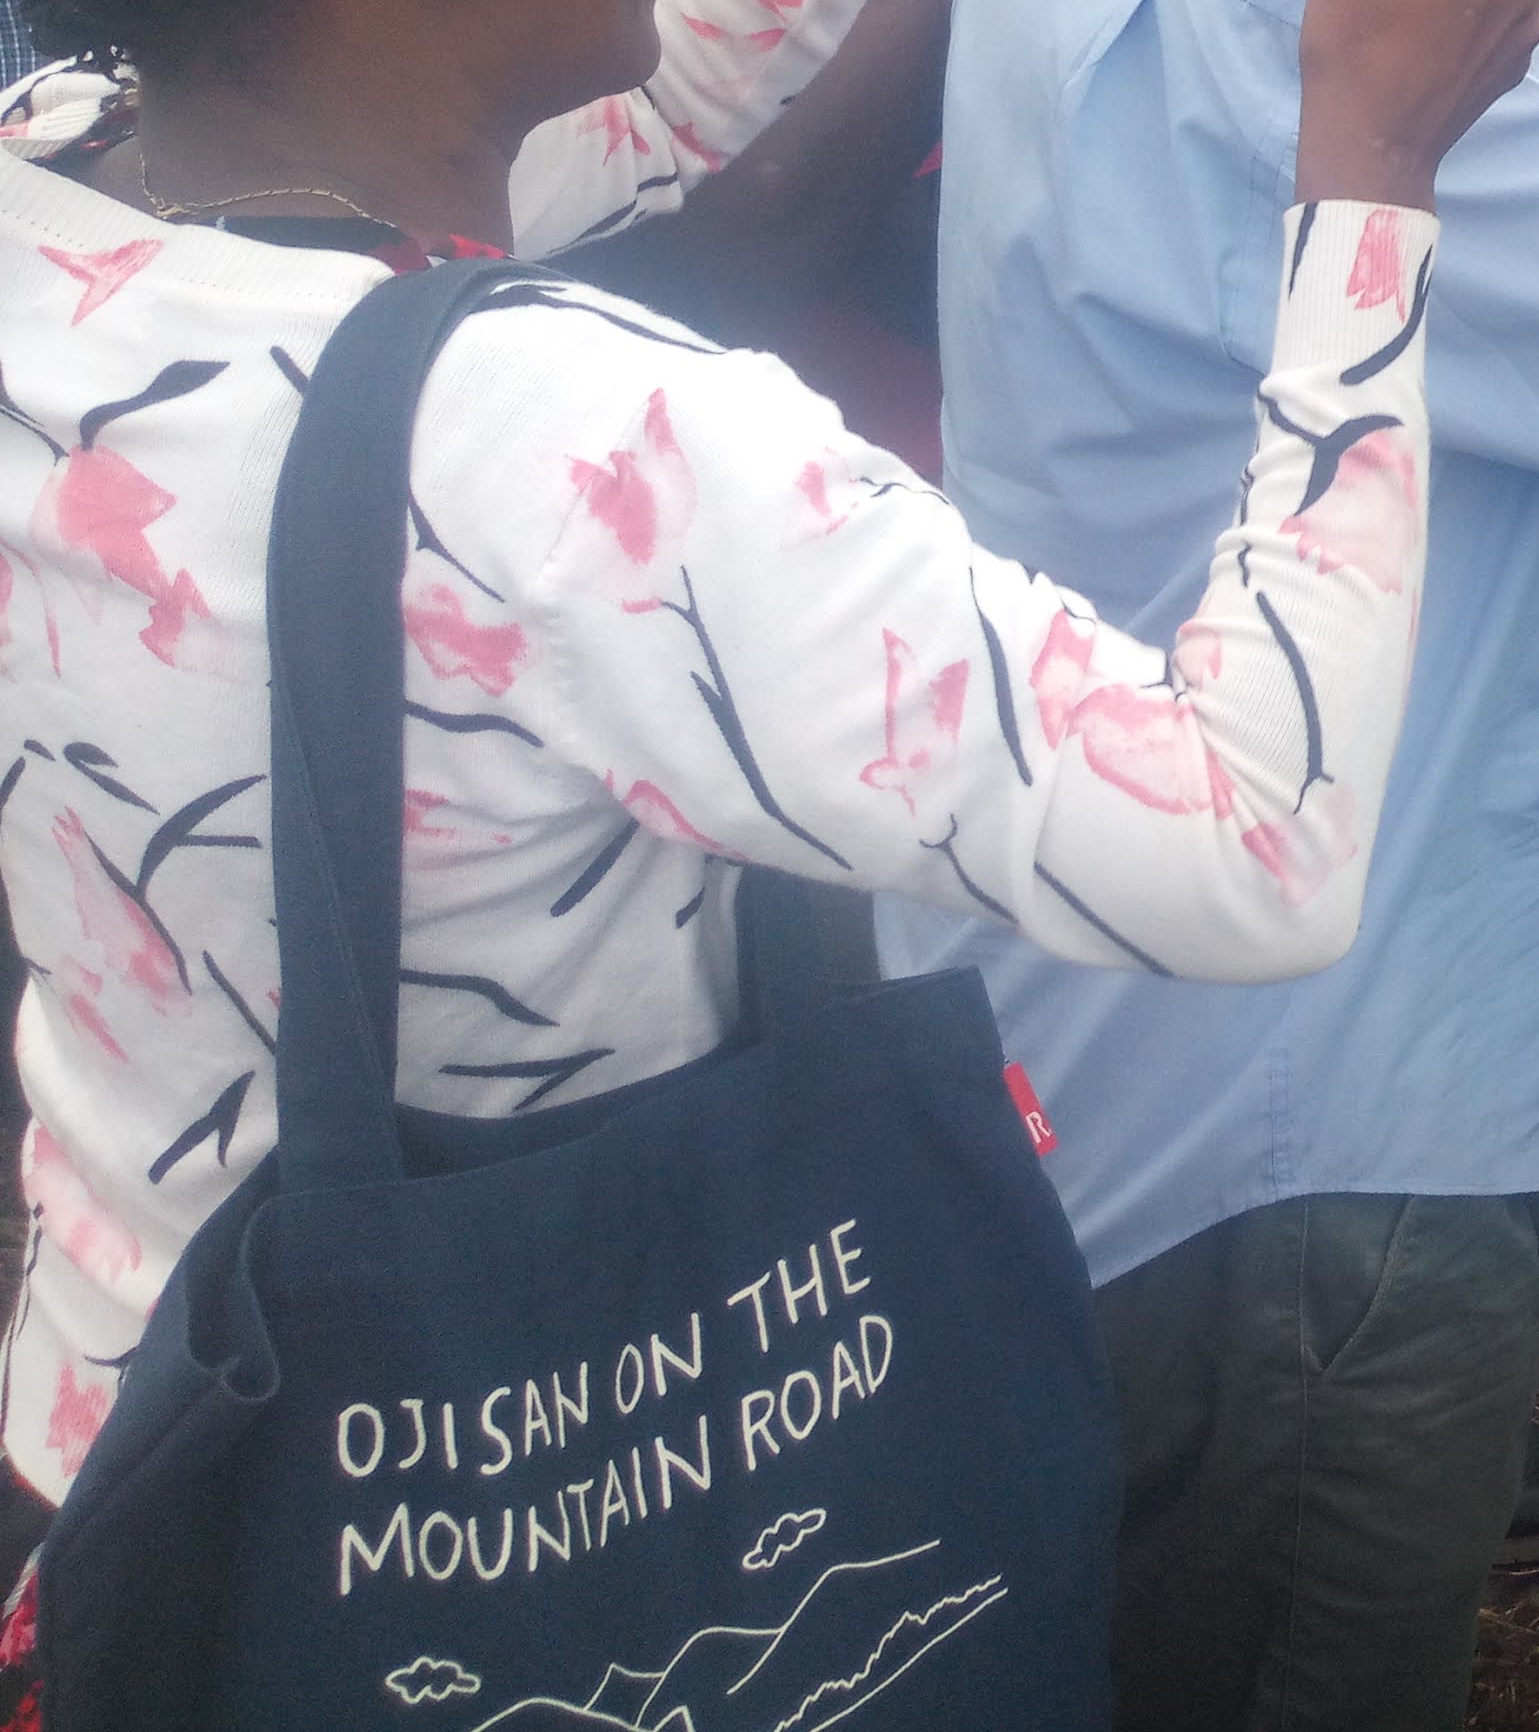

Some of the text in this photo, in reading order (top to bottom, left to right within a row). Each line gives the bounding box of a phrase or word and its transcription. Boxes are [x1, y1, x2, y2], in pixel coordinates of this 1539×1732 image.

[337, 1218, 871, 1478] OJISAN ON THE
[340, 1315, 893, 1596] MOUNTAIN ROAD
